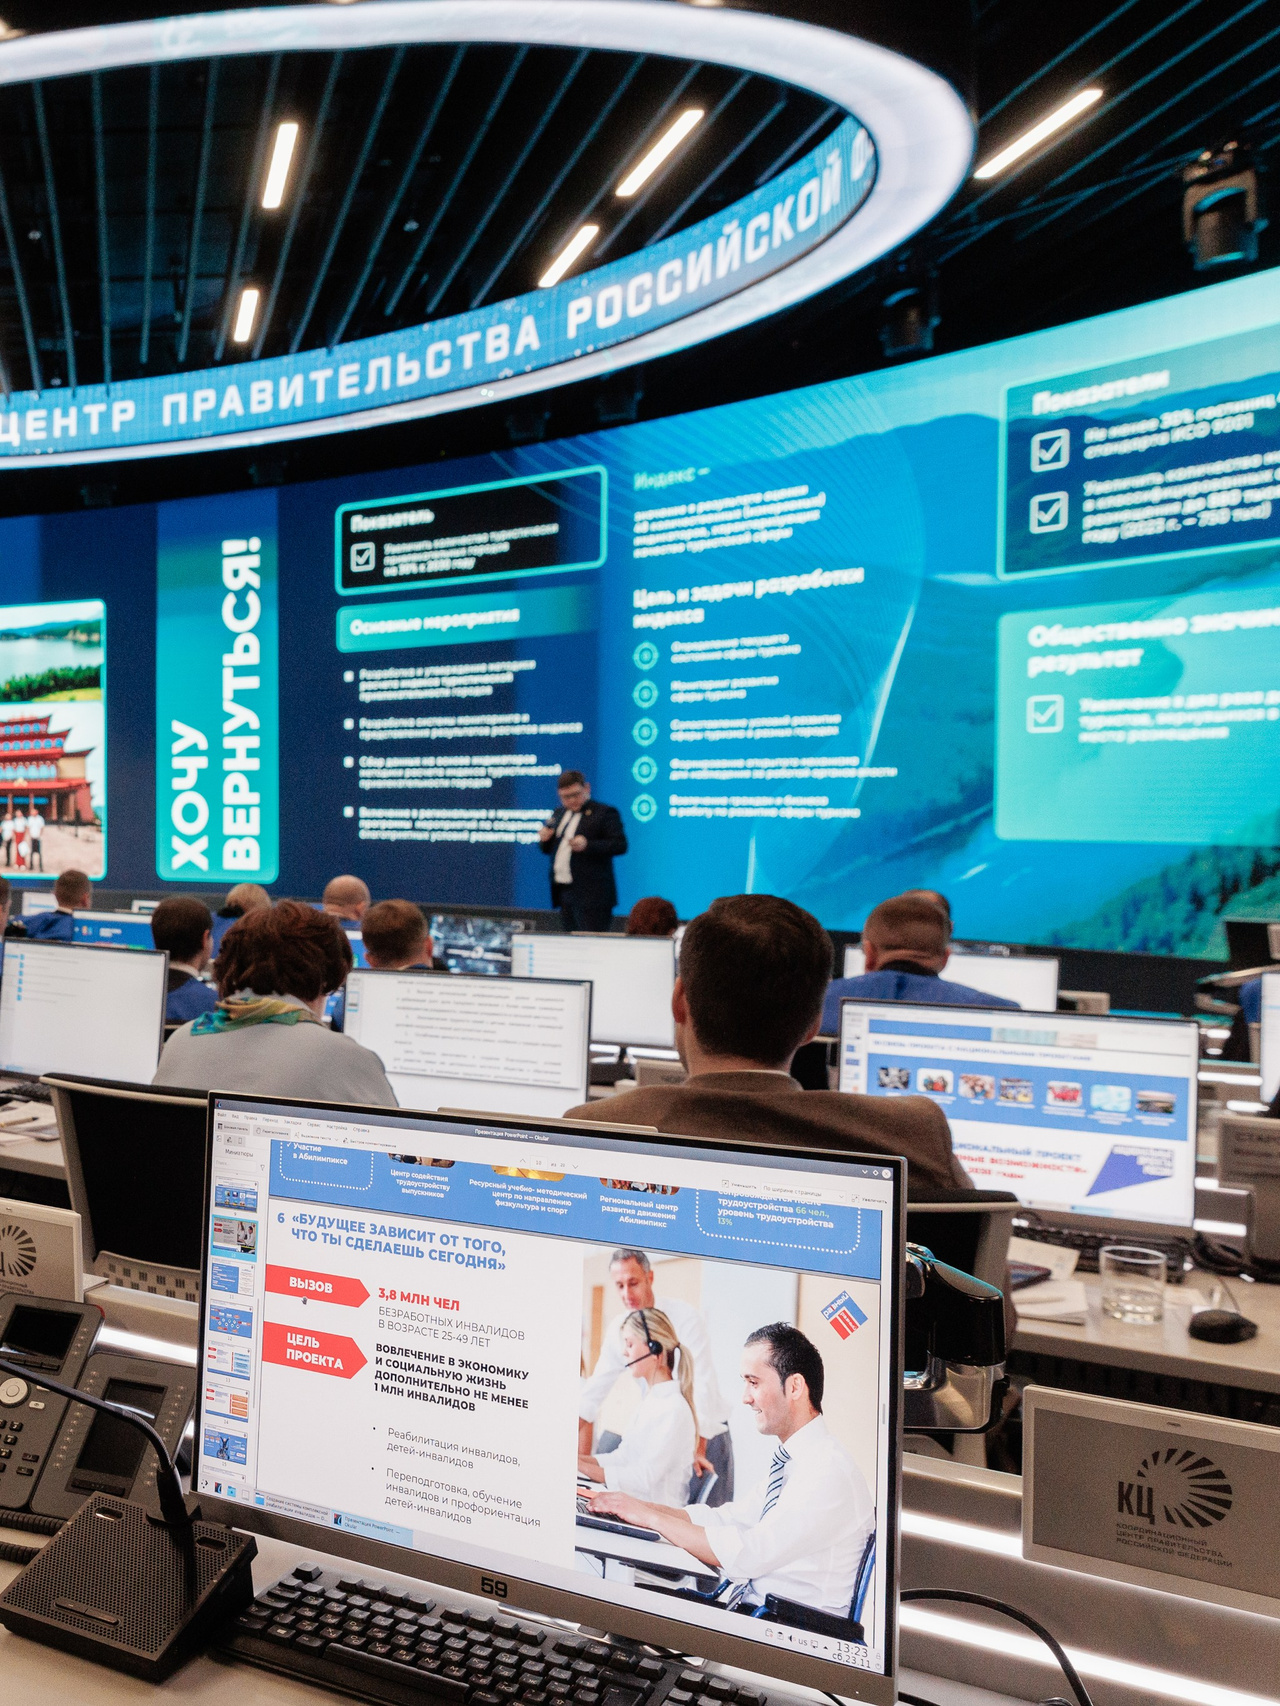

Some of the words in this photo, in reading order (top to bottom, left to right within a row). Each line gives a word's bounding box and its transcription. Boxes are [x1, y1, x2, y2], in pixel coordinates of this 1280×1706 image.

[162, 314, 540, 427] ПРАВИТЕЛЬСТВА
[567, 148, 843, 340] РОССИЙСКОЙ
[220, 534, 263, 872] ВЕРНУТЬСЯ!
[170, 719, 210, 871] ХОЧУ
[293, 1142, 322, 1152] Участие
[299, 1153, 348, 1165] Абилимпиксе
[390, 1168, 409, 1181] Центр
[410, 1171, 449, 1183] содействия
[396, 1179, 451, 1193] трудоустройству
[401, 1187, 444, 1199] выпускников
[469, 1179, 506, 1193] Ресурсный
[508, 1184, 535, 1195] учебно-
[537, 1186, 587, 1200] методический
[492, 1190, 512, 1202] центр
[513, 1194, 523, 1203] по
[524, 1195, 572, 1207] направлению
[495, 1198, 539, 1212] физкультура
[547, 1206, 568, 1217] спорт
[600, 1195, 655, 1210] Региональный
[655, 1202, 679, 1213] центр
[601, 1205, 636, 1217] развития
[637, 1210, 677, 1221] движения
[718, 1198, 794, 1214] трудоустройства
[795, 1207, 807, 1216] 66
[808, 1209, 830, 1219] чел.,
[619, 1215, 667, 1228] Абилимпикс
[717, 1208, 755, 1221] уровень
[756, 1213, 834, 1230] трудоустройства
[718, 1217, 733, 1227] 13%
[277, 1212, 285, 1224] 6
[291, 1212, 365, 1235] «БУДУЩЕЕ
[369, 1223, 435, 1244] ЗАВИСИТ
[439, 1233, 459, 1248] ОТ
[462, 1236, 507, 1257] ТОГО,
[291, 1228, 318, 1242] ЧТО
[321, 1232, 342, 1246] ТЫ
[345, 1235, 424, 1260] СДЕЛАЕШЬ
[428, 1248, 507, 1271] СЕГОДНЯ»
[289, 1276, 333, 1293] ВЫЗОВ
[378, 1287, 397, 1301] 3,8
[400, 1291, 430, 1307] МЛН
[433, 1296, 460, 1311] ЧЕЛ
[378, 1306, 453, 1328] БЕЗРАБОТНЫХ
[455, 1318, 526, 1341] ИНВАЛИДОВ
[378, 1319, 384, 1328] В
[387, 1321, 439, 1339] ВОЗРАСТЕ
[441, 1330, 468, 1344] 25-49
[470, 1336, 491, 1348] ЛЕТ
[287, 1332, 320, 1349] ЦЕЛЬ
[286, 1349, 344, 1370] ПРОЕКТА
[376, 1343, 445, 1365] ВОВЛЕЧЕНИЕ
[448, 1356, 456, 1367] В
[458, 1359, 530, 1381] ЭКОНОМИКУ
[375, 1356, 383, 1367] И
[385, 1358, 463, 1382] СОЦИАЛЬНУЮ
[465, 1374, 507, 1390] ЖИЗНЬ
[374, 1369, 471, 1397] ДОПОЛНИТЕЛЬНО
[473, 1389, 489, 1400] НЕ
[491, 1392, 529, 1409] МЕНЕЕ
[374, 1383, 378, 1392] 1
[380, 1383, 405, 1397] МЛН
[407, 1389, 476, 1412] ИНВАЛИДОВ
[387, 1441, 474, 1470] детей-инвалидов
[388, 1427, 459, 1452] Реабилитация
[461, 1446, 521, 1467] инвалидов,
[386, 1467, 470, 1498] Переподготовка,
[472, 1489, 523, 1509] обучение
[384, 1495, 472, 1525] детей-инвалидов
[385, 1482, 440, 1502] инвалидов
[442, 1496, 448, 1504] и
[451, 1496, 541, 1528] профориентация
[1118, 1481, 1155, 1525] КЦ
[1116, 1523, 1208, 1546] КООРДИНАЦИОННЫЙ
[1116, 1530, 1144, 1541] ЦЕНТР
[1147, 1536, 1223, 1558] ПРАВИТЕЛЬСТВА
[1116, 1538, 1174, 1555] РОССИЙСКОЙ
[1178, 1551, 1232, 1568] ФЕДЕРАЦИИ
[481, 1576, 507, 1599] 59
[836, 1642, 868, 1658] 13:23
